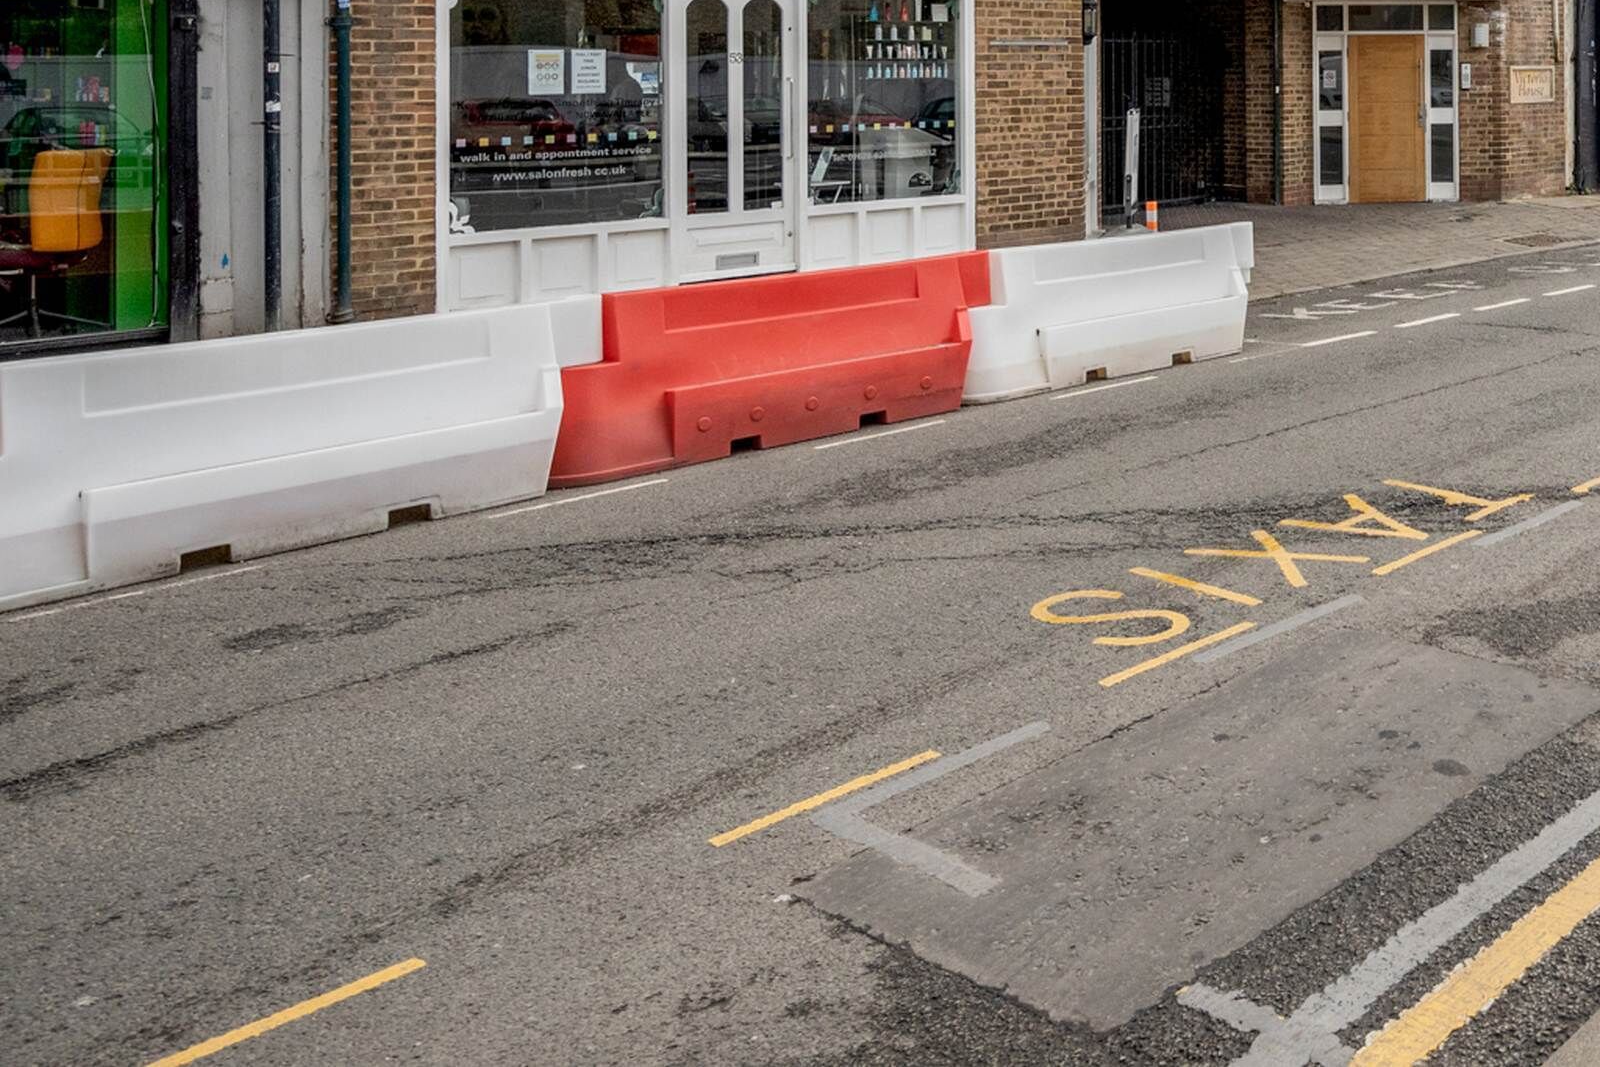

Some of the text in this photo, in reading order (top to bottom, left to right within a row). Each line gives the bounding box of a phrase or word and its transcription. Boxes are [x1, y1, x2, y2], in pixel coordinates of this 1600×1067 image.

[729, 52, 743, 64] 53
[460, 145, 653, 163] walk in and appointment service
[1029, 478, 1535, 647] TAXIS
